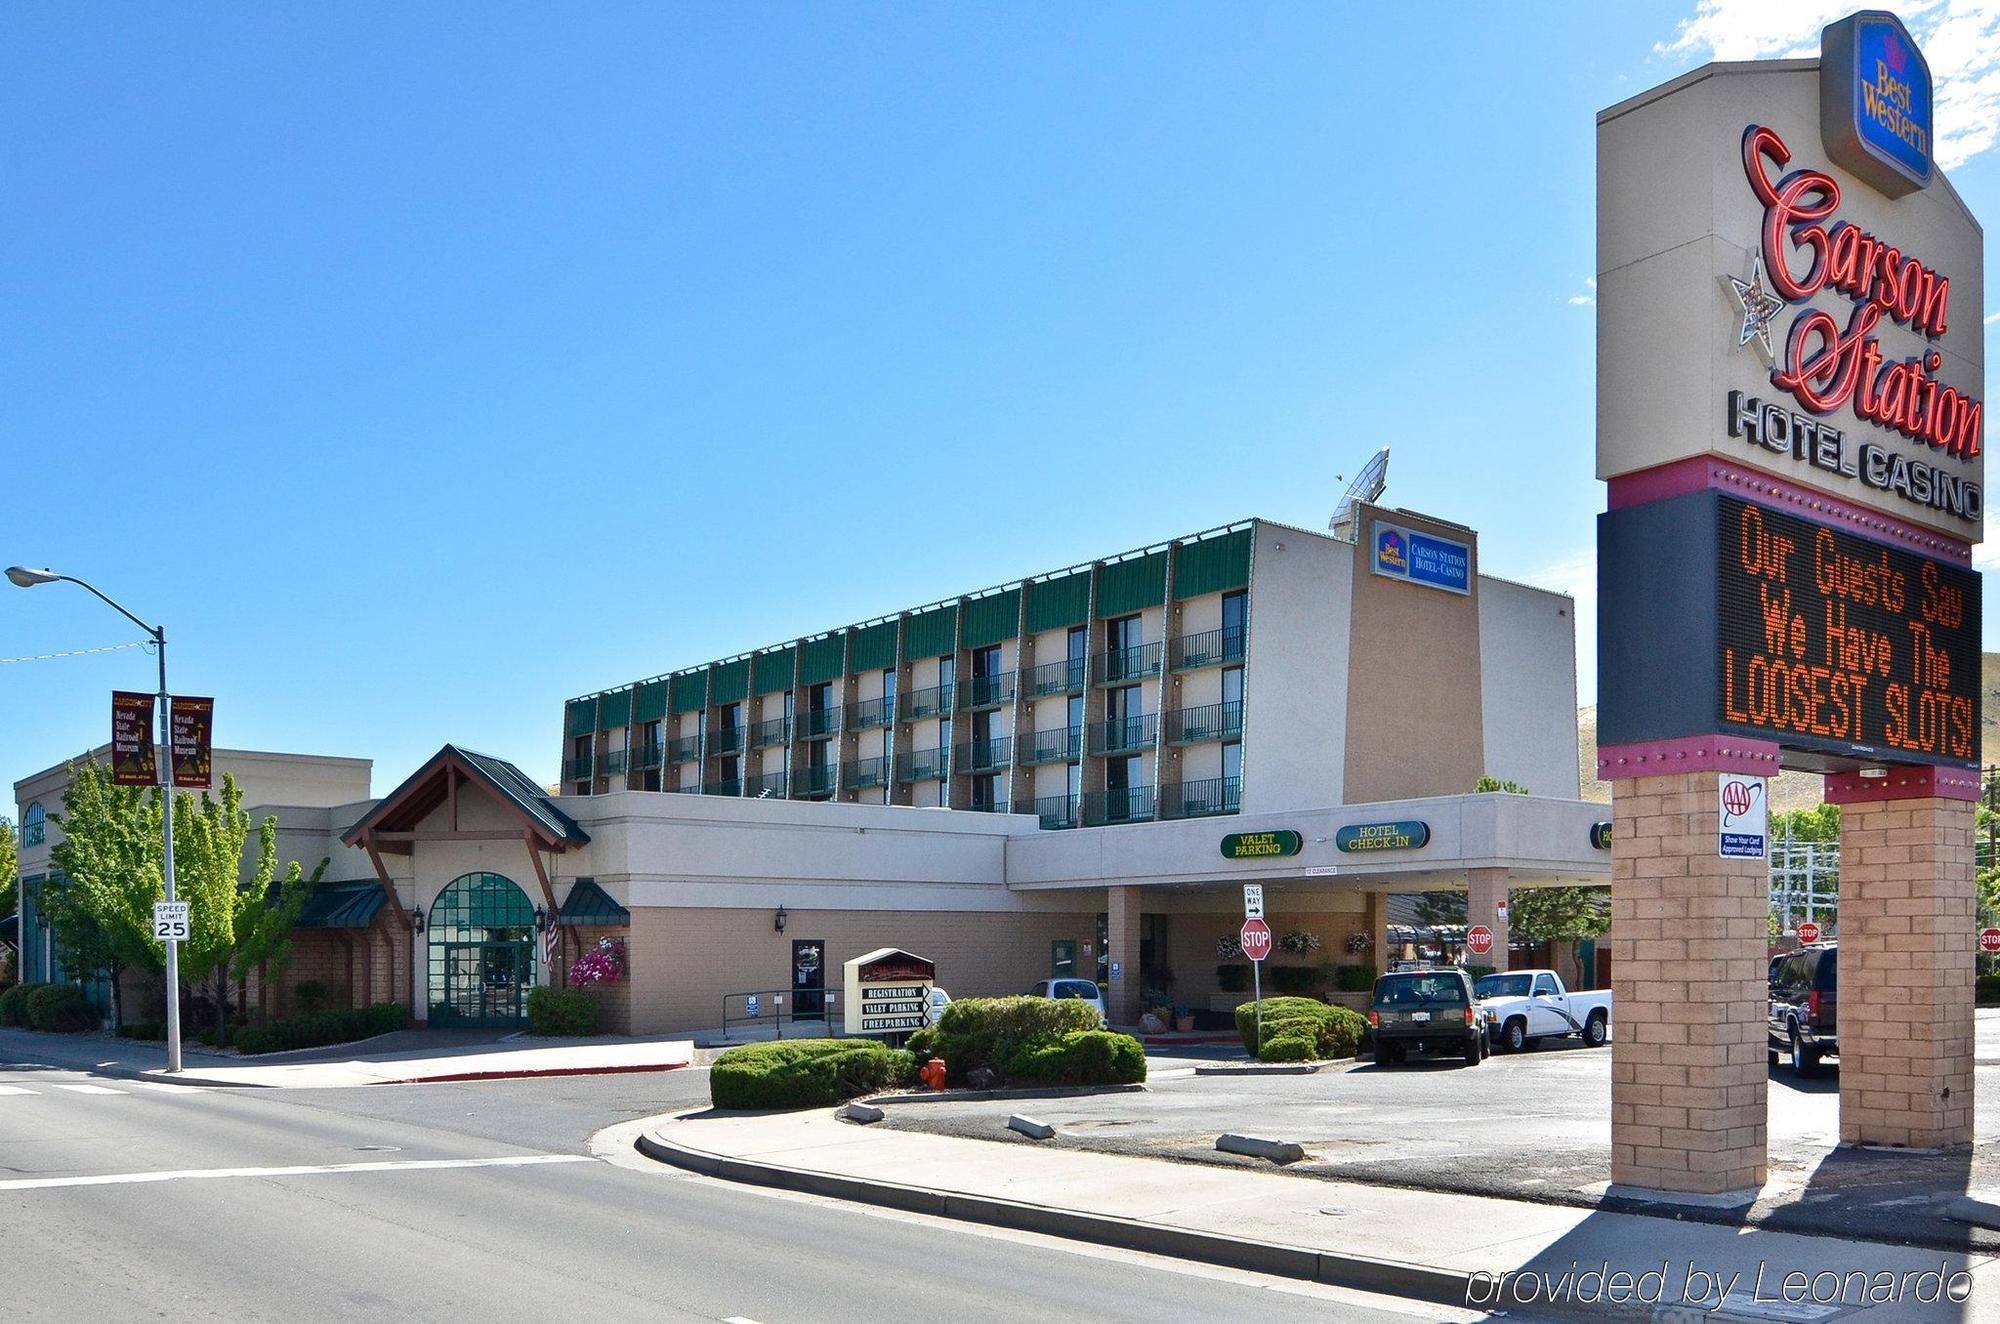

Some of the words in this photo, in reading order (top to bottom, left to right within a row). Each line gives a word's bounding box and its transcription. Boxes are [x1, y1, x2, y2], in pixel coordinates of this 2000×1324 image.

[1876, 57, 1912, 115] Best
[1861, 78, 1927, 156] Western
[1742, 124, 1951, 337] Carson
[1770, 300, 1983, 460] Station
[1729, 390, 1857, 479] HOTEL
[1860, 443, 1984, 521] CASINO
[1385, 543, 1400, 557] Best
[1379, 551, 1406, 567] Western
[1741, 504, 1795, 583] Our
[1815, 527, 1905, 613] Guests
[1922, 560, 1963, 629] Say
[1760, 582, 1807, 660] We
[1826, 599, 1893, 677] Have
[1909, 620, 1950, 690] The
[1726, 649, 1867, 740] LOOSEST
[1885, 682, 1972, 758] SLOTS!
[116, 711, 136, 720] Nevada
[174, 714, 194, 724] Nevada
[116, 721, 130, 730] State
[174, 725, 188, 734] State
[116, 731, 139, 741] Railroad
[174, 735, 197, 744] Railroad
[116, 742, 139, 752] Museum
[174, 745, 197, 754] Museum
[1726, 783, 1748, 815] AAA
[1359, 824, 1398, 836] HOTEL
[1239, 834, 1275, 845] VALET
[1349, 835, 1409, 850] CHECK-IN
[1724, 835, 1737, 844] Show
[1738, 836, 1748, 844] Your
[1749, 837, 1760, 845] Card
[1235, 843, 1280, 856] PARKING
[1722, 844, 1744, 854] Approved
[1744, 845, 1762, 856] Lodging
[1246, 888, 1260, 896] ONE
[1247, 897, 1260, 905] WAY
[158, 922, 185, 936] 25
[1798, 928, 1818, 938] STOP
[1244, 931, 1268, 947] STOP
[1469, 934, 1491, 945] STOP
[868, 988, 917, 998] REGISTRATION
[865, 1004, 886, 1014] VALET
[889, 1002, 919, 1013] PARKING
[864, 1020, 885, 1029] FREE
[885, 1018, 920, 1028] PARKING
